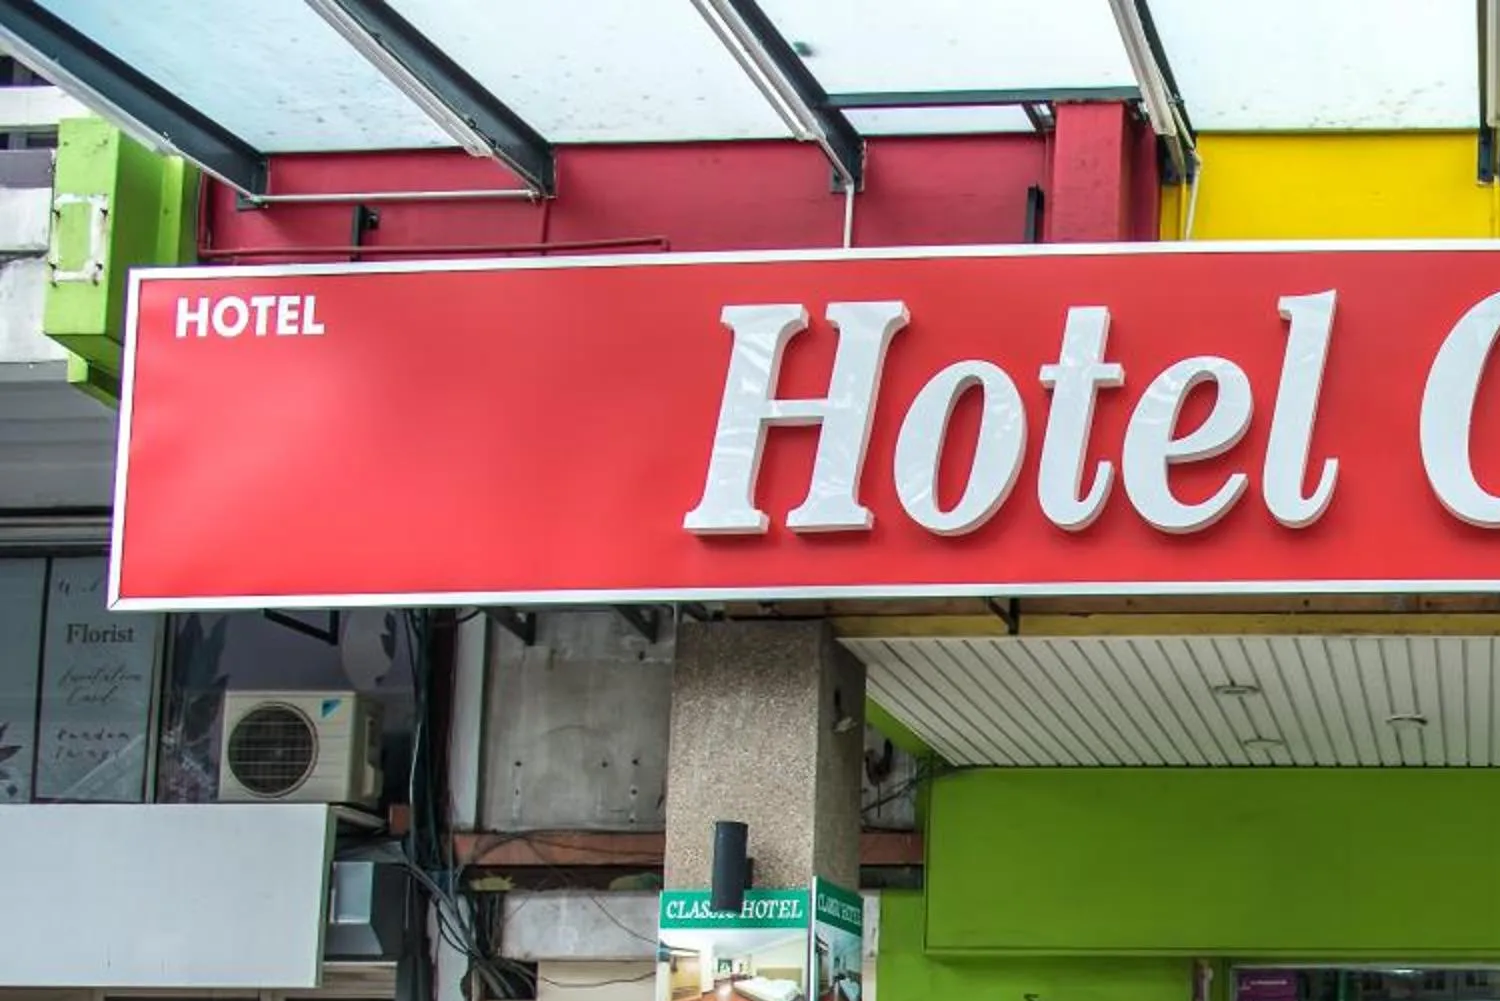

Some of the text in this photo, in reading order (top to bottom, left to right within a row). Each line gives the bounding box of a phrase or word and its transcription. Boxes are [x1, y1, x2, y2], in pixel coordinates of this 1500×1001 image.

[175, 295, 325, 337] HOTEL
[682, 288, 1340, 537] Hotel
[66, 623, 135, 644] Florist
[666, 899, 803, 919] CLAS HOTEL
